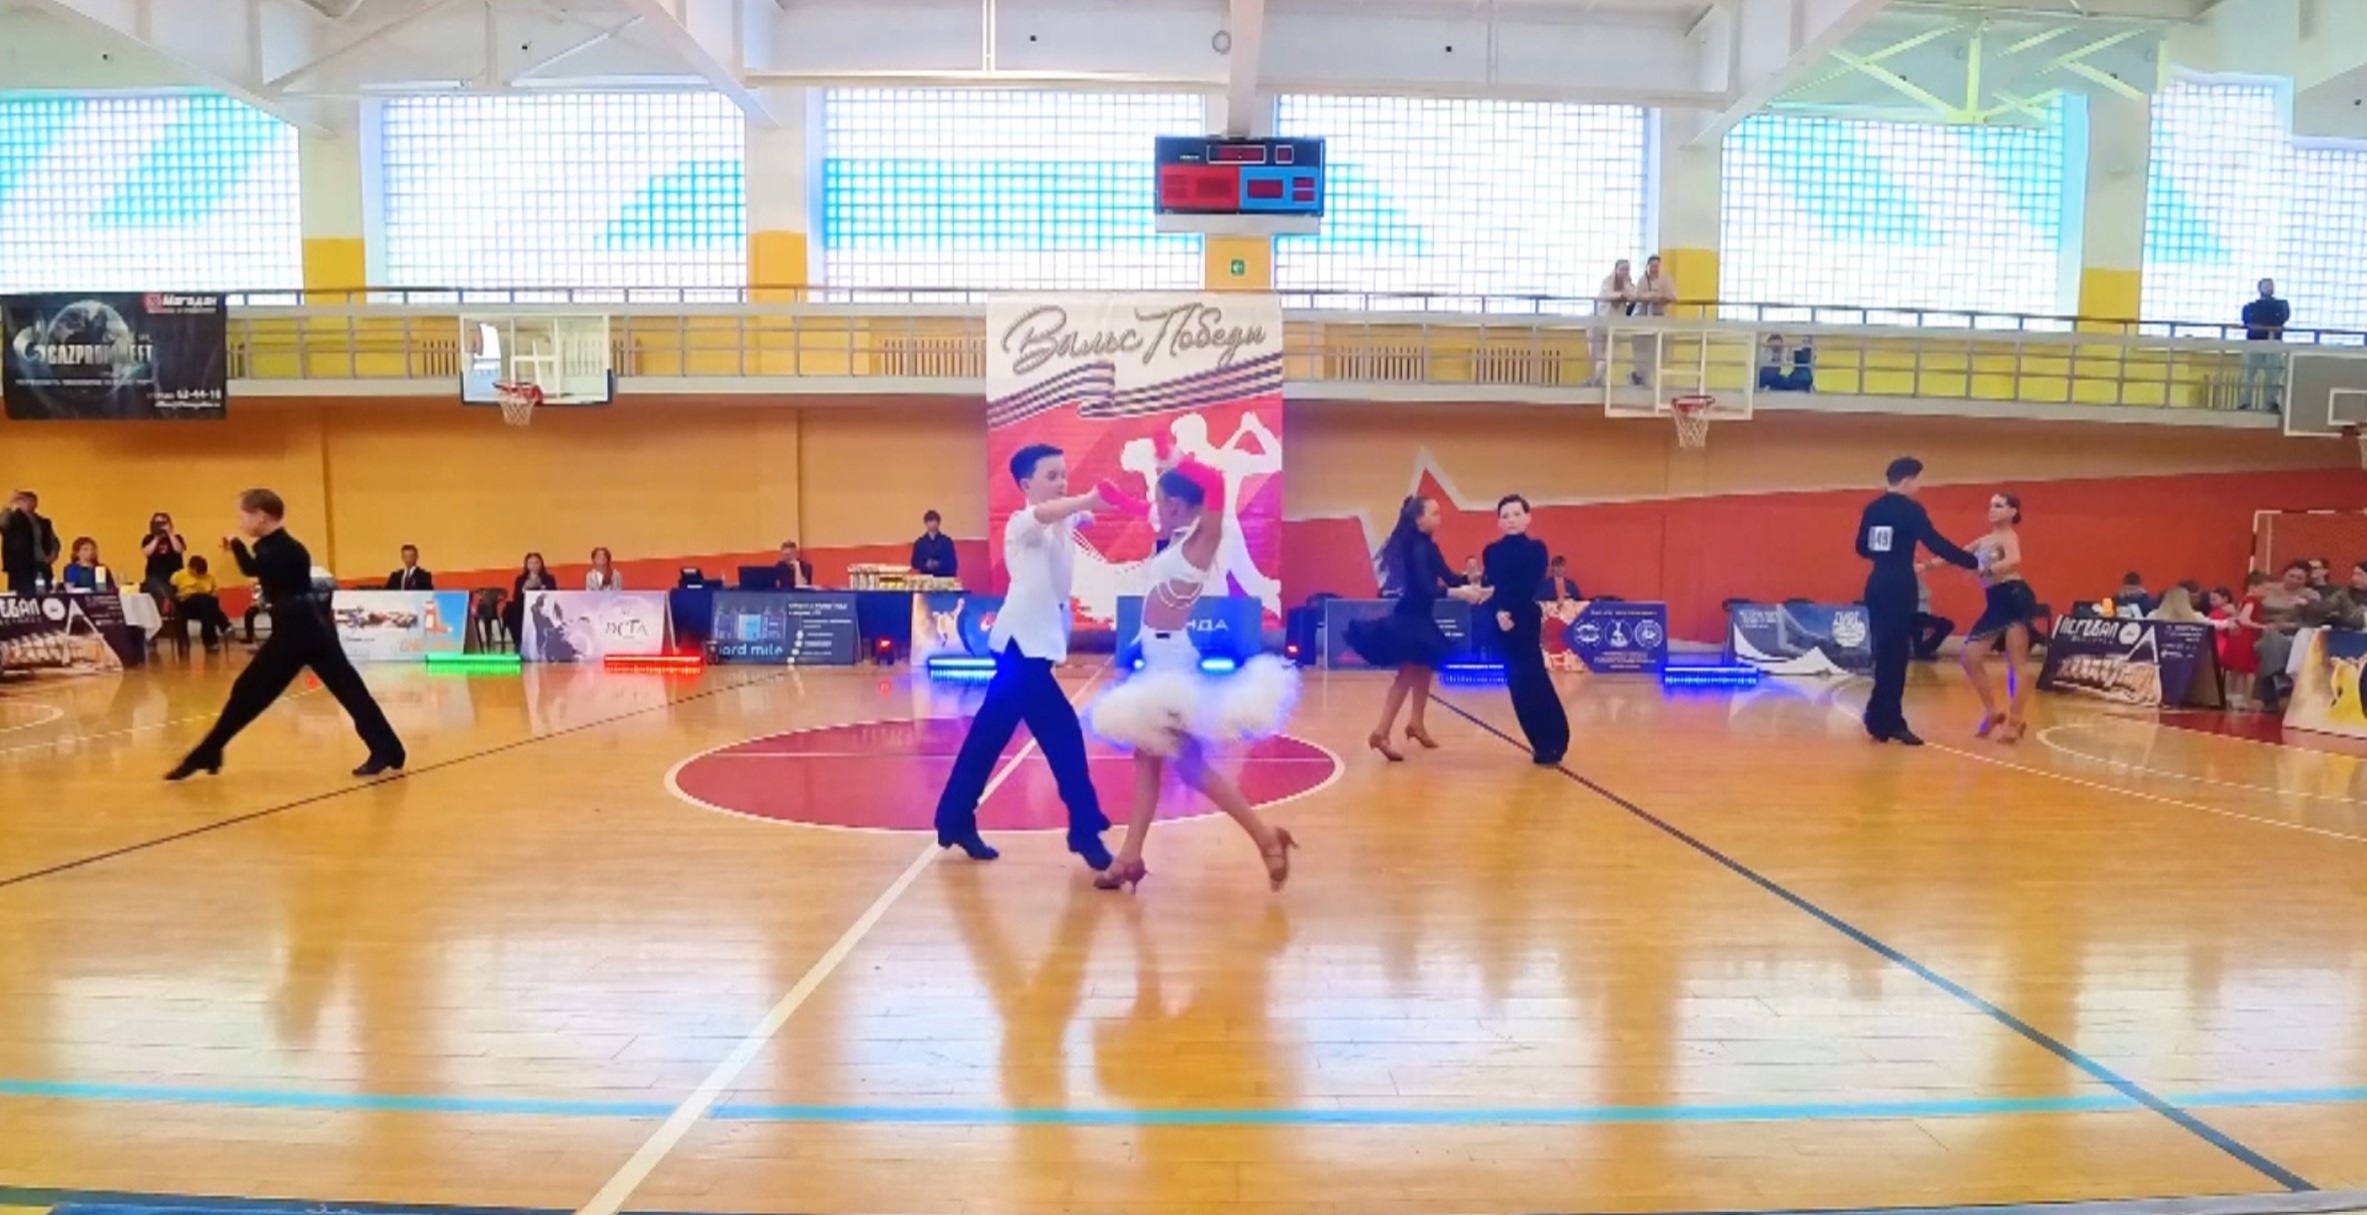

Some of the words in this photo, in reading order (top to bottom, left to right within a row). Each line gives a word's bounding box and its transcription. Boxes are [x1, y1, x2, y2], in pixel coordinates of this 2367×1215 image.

[1001, 304, 1143, 375] Вальс
[1134, 302, 1266, 368] Победы
[751, 643, 784, 656] mile
